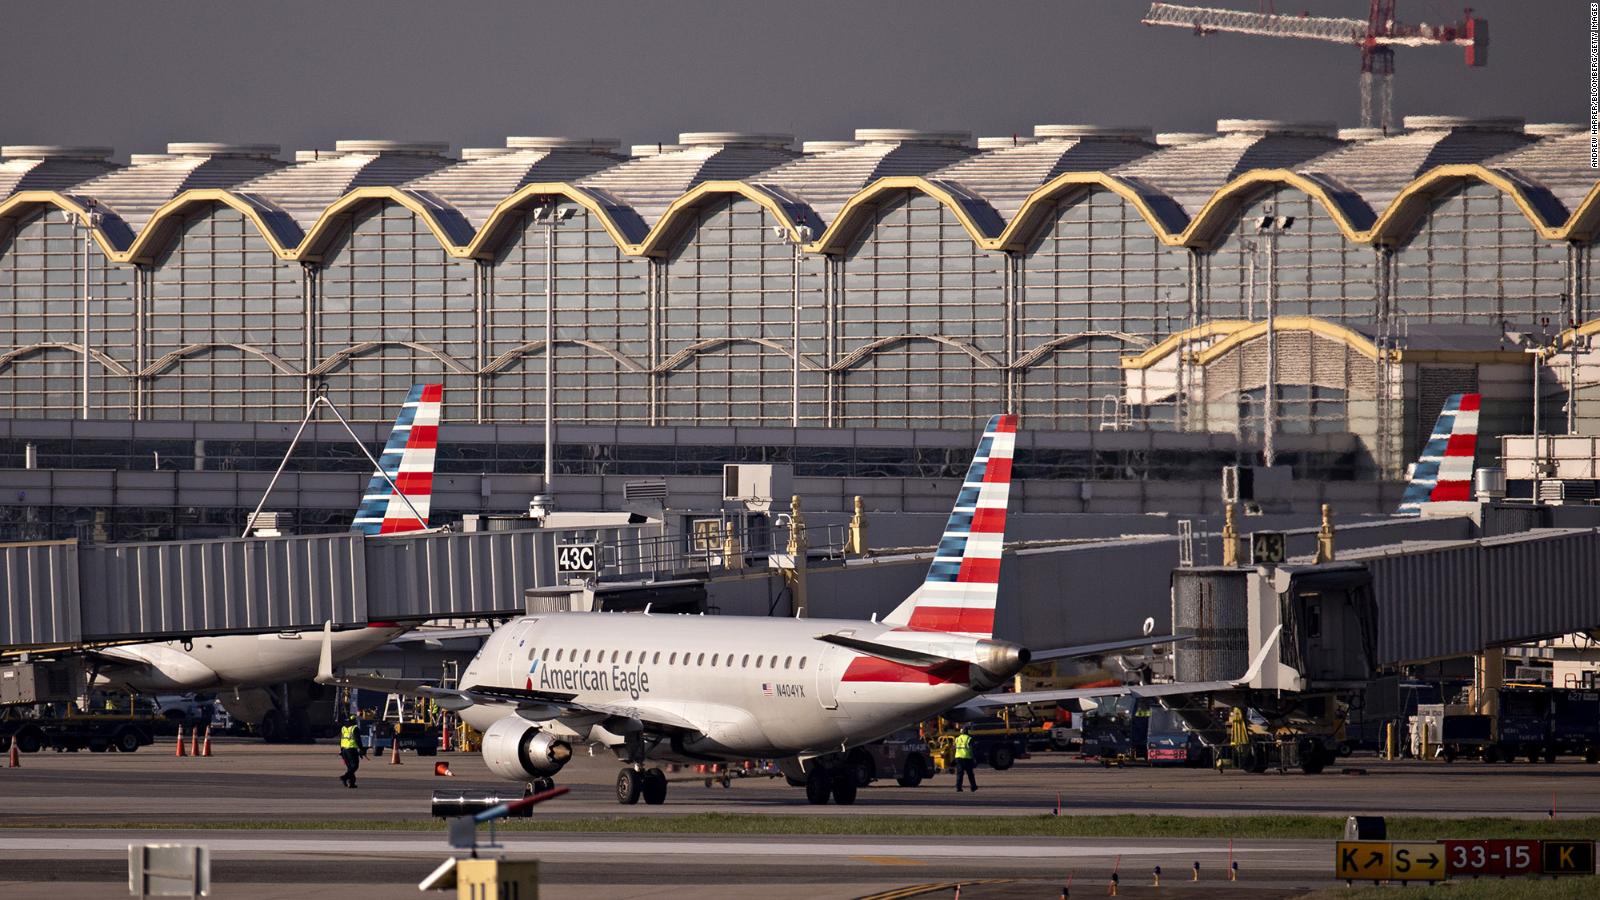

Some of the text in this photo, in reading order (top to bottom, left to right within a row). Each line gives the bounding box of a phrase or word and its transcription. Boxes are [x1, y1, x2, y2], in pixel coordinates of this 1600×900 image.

[560, 547, 593, 570] 43C
[1255, 535, 1283, 561] 43
[540, 663, 650, 700] American Eagle
[776, 683, 806, 698] N404YX
[1342, 848, 1359, 872] K
[1395, 849, 1411, 872] S
[1452, 845, 1530, 869] 33-15
[1559, 846, 1576, 868] K
